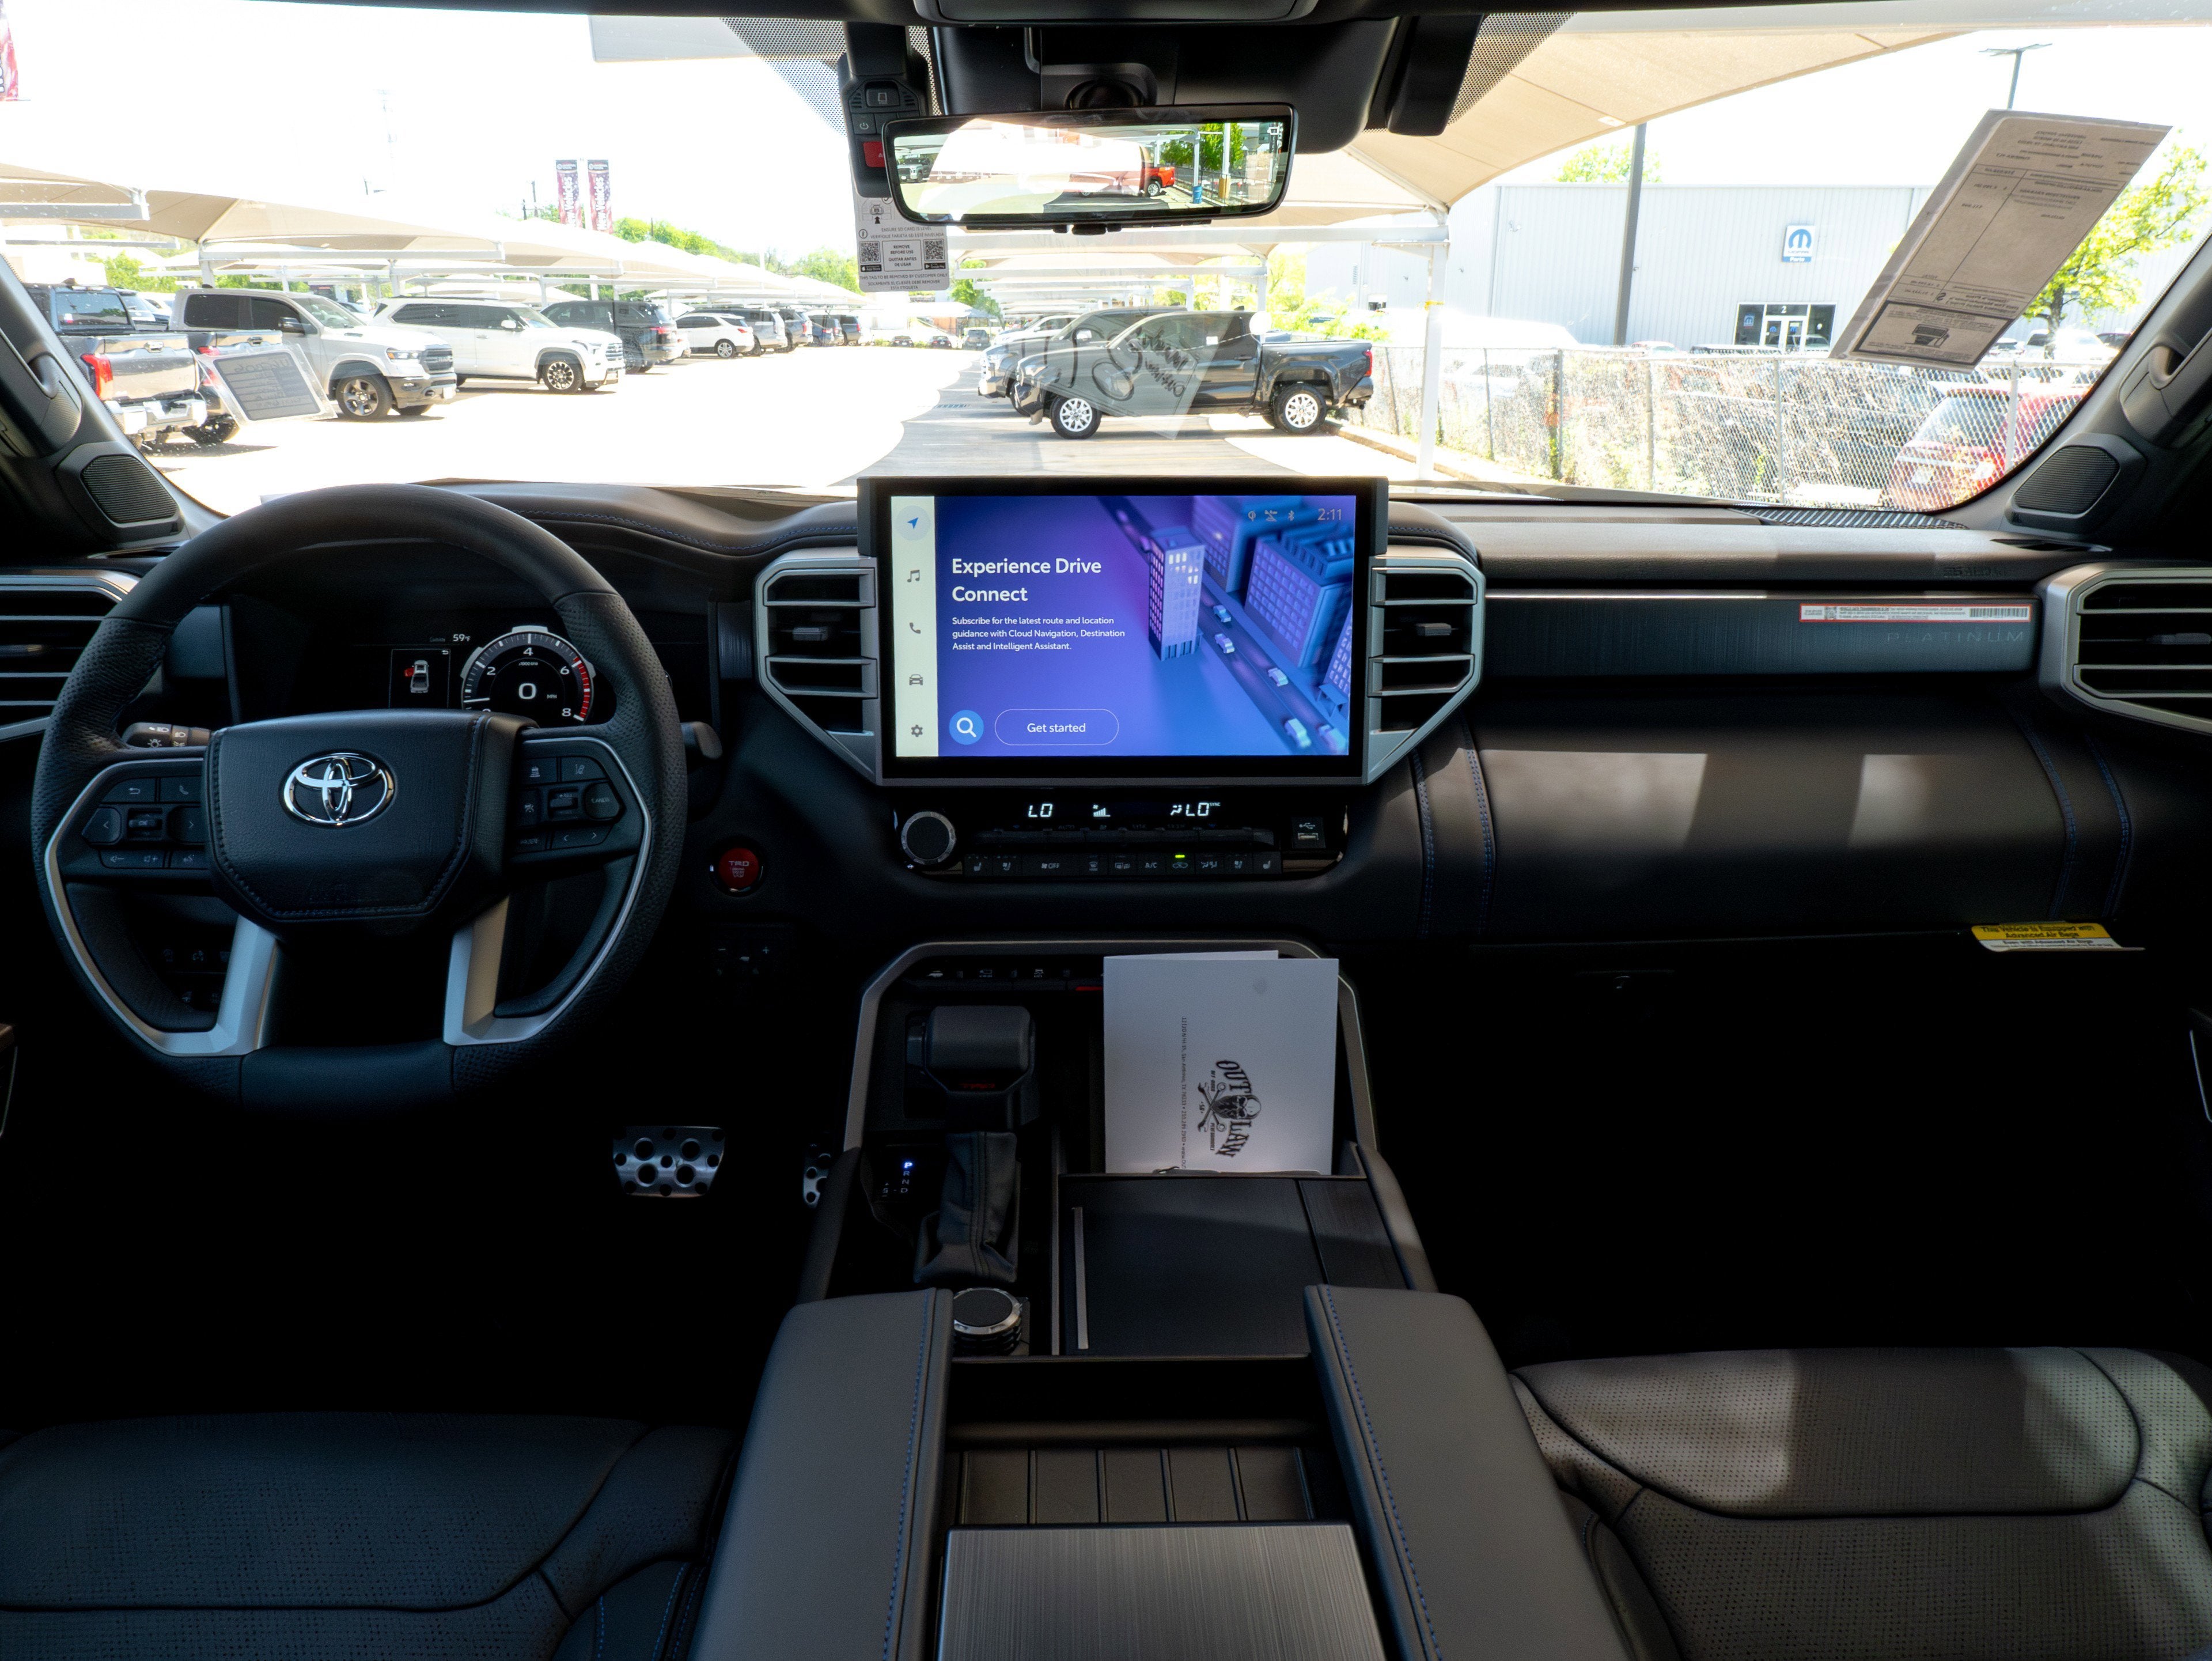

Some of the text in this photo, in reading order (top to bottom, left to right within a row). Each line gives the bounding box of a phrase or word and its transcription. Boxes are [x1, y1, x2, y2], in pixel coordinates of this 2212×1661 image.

[594, 176, 606, 211] Vehicles
[1781, 305, 1787, 314] 2
[1317, 508, 1342, 521] 2:11
[952, 558, 1102, 578] Experience Drive
[952, 586, 1028, 602] Connect
[952, 617, 991, 625] Subscribe
[1065, 616, 1081, 625] and
[1082, 616, 1115, 625] location
[952, 630, 989, 639] guidance
[1034, 630, 1079, 639] Navigation,
[1887, 631, 2024, 642] PLATINUM
[523, 647, 533, 656] 4
[952, 642, 1072, 652] Assist and Intelligent Assistant.
[487, 667, 496, 675] 2
[560, 667, 570, 675] 6
[518, 683, 537, 699] 0
[562, 707, 571, 717] 8
[1027, 722, 1086, 733] Get started
[1028, 803, 1053, 818] LO
[1185, 802, 1209, 816] LO
